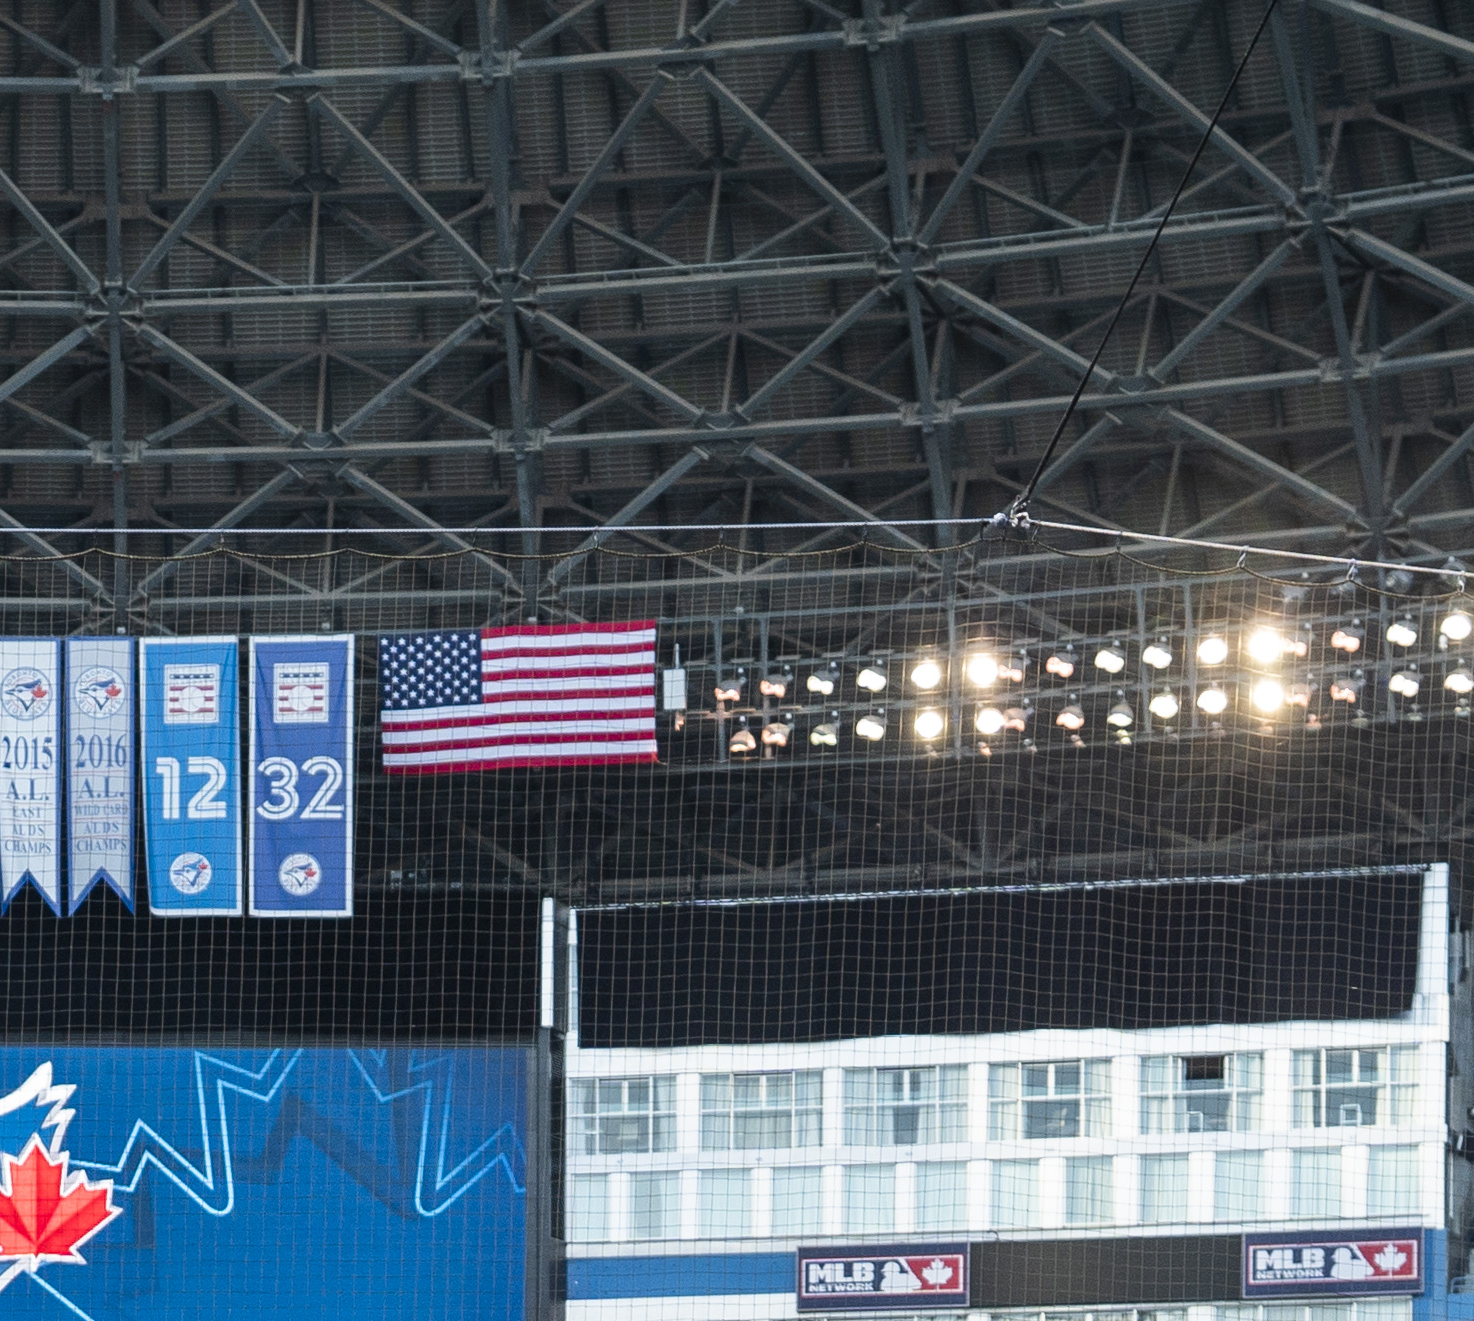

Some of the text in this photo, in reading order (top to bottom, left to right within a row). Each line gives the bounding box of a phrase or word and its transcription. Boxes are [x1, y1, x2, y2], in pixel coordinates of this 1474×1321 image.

[3, 735, 52, 770] 2015
[75, 734, 127, 768] 2016
[7, 778, 50, 801] A.L.
[79, 777, 124, 799] A.L.
[156, 756, 227, 820] 12
[256, 755, 345, 820] 32
[4, 839, 52, 854] CHAMPS
[76, 838, 127, 852] CHAMPS
[1256, 1248, 1324, 1271] MLB
[808, 1262, 875, 1283] MLB
[1256, 1267, 1324, 1279] NETWORK
[808, 1282, 875, 1293] NETWORK
